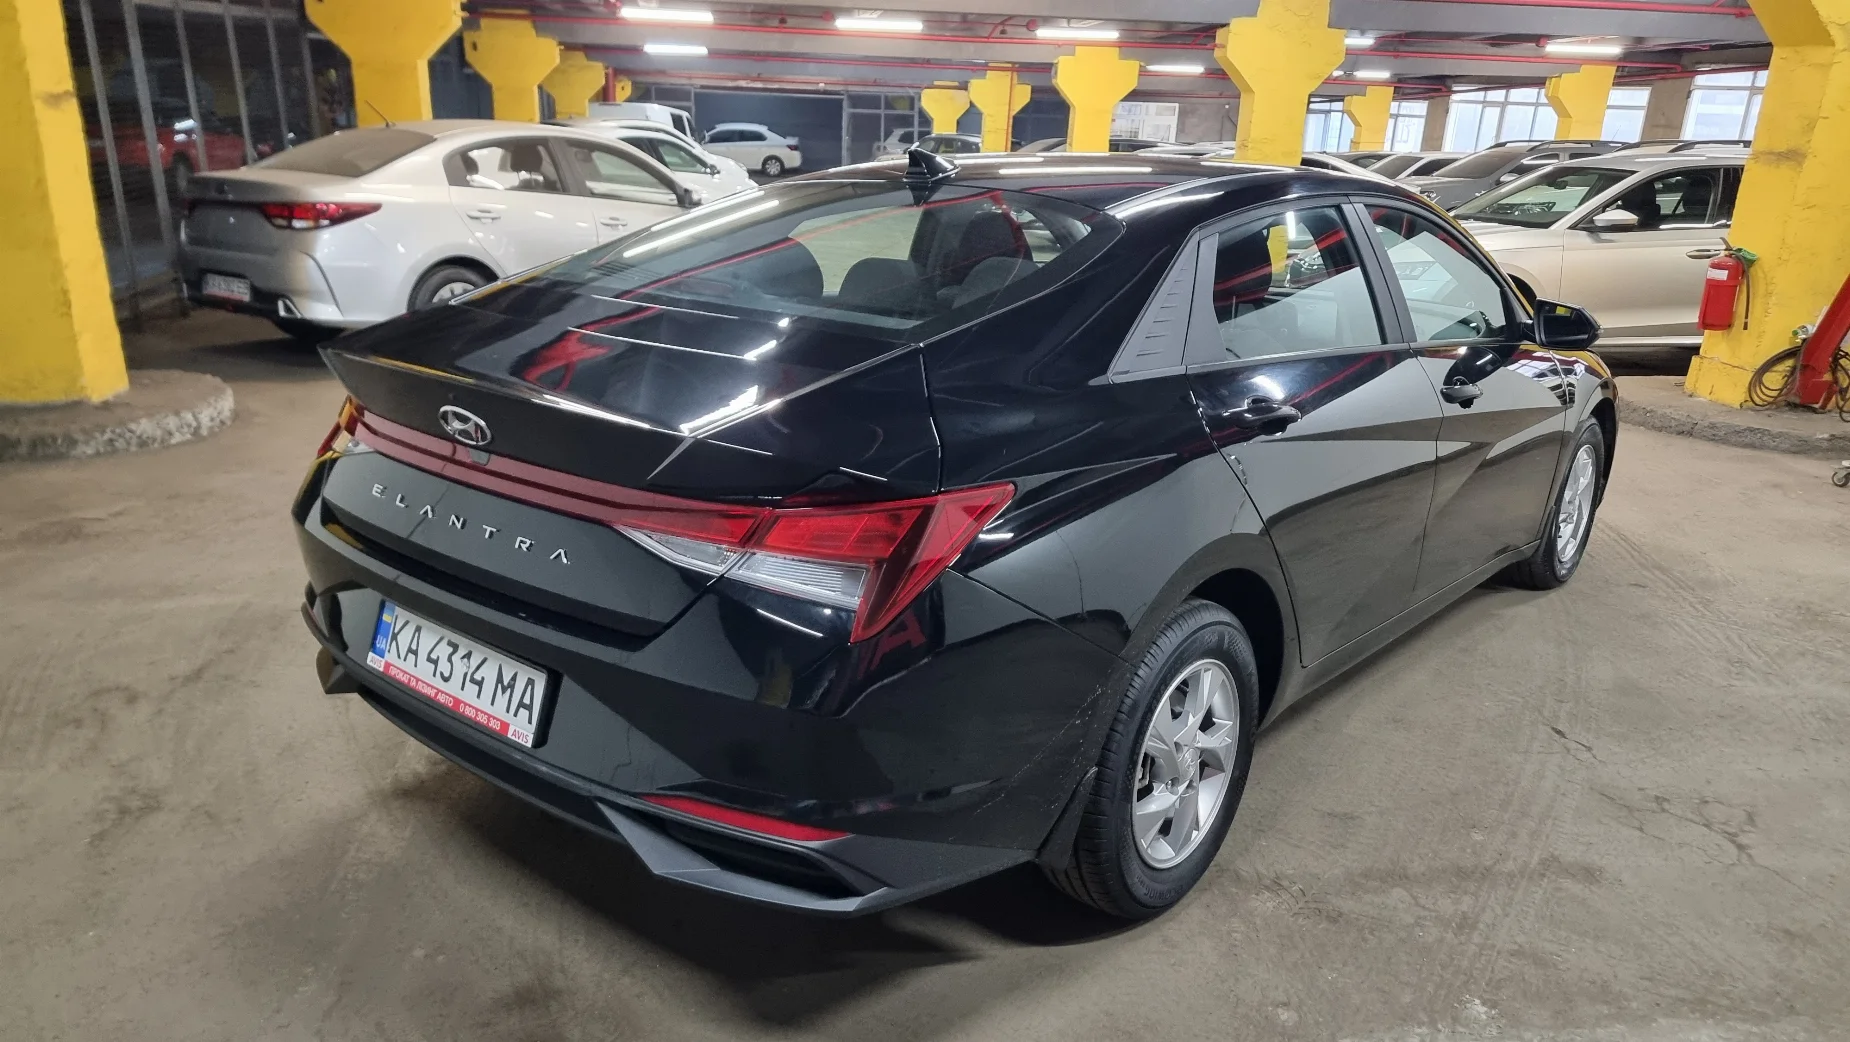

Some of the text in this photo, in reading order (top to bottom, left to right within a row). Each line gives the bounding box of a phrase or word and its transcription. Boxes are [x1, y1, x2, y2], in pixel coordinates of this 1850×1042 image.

[371, 483, 570, 564] ELANTRA
[376, 634, 387, 649] UA
[369, 655, 383, 669] AVIS
[387, 614, 536, 725] KA 4314 MA
[388, 665, 410, 684] ПРОКАТ
[409, 677, 417, 689] ТА
[437, 691, 454, 707] АВТО
[459, 703, 464, 713] 0
[464, 705, 476, 718] 800
[476, 711, 488, 724] 305
[488, 717, 501, 730] 303
[511, 728, 530, 744] AVIS
